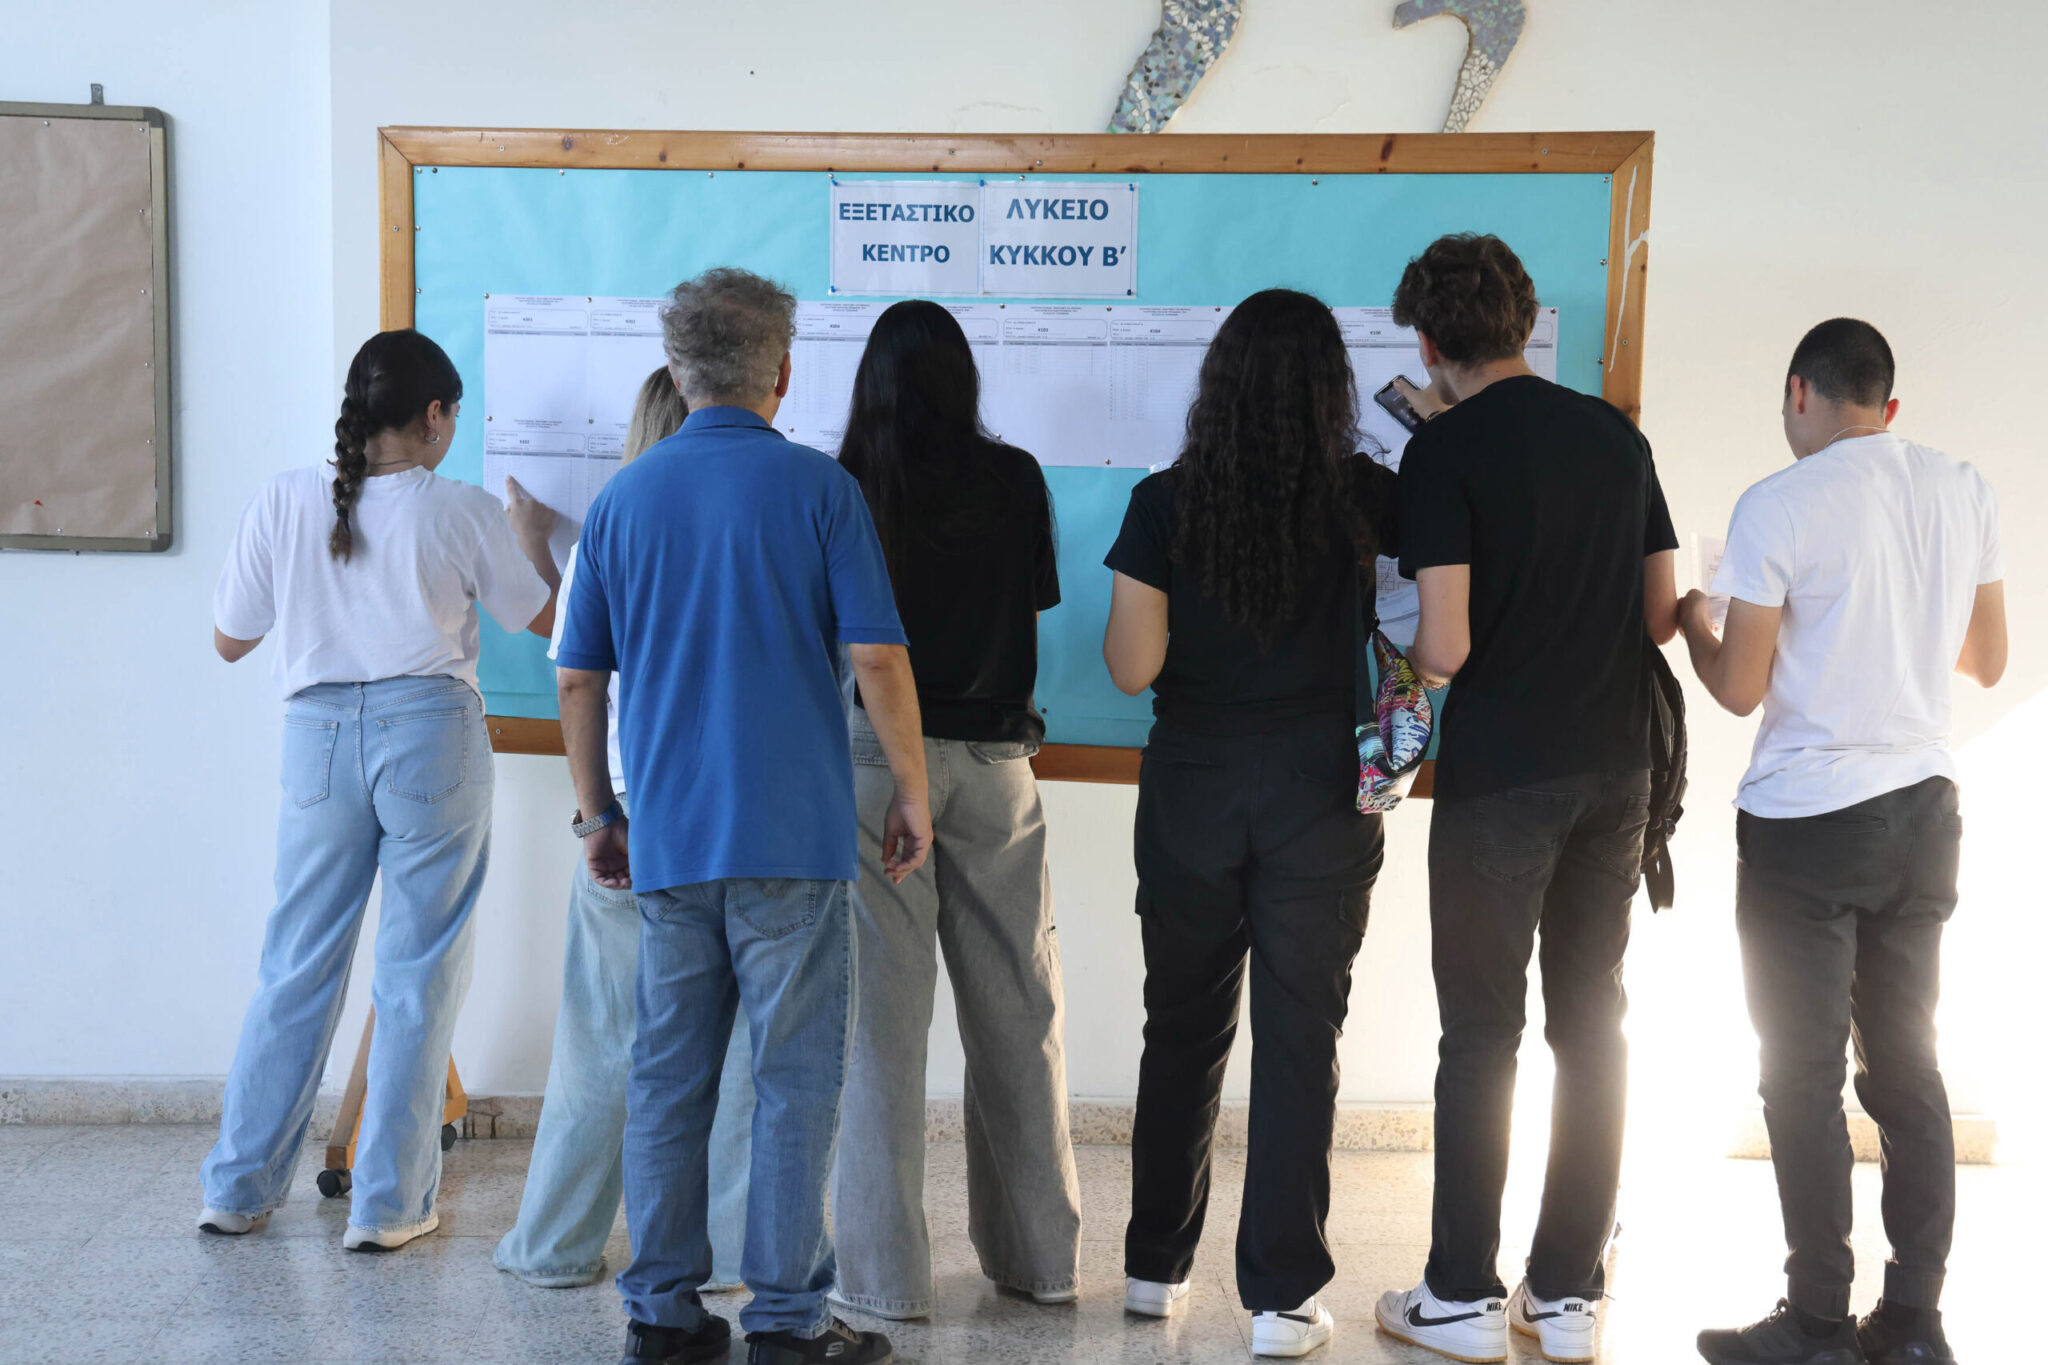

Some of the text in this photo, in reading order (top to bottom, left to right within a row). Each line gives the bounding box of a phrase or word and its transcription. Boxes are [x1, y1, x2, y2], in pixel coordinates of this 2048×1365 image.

[839, 203, 975, 223] ΕΞΕΤΑΣΤΙΚΟ
[1006, 198, 1109, 221] ΛΥΚΕΙΟ
[862, 244, 950, 263] ΚΕΝΤΡΟ
[990, 245, 1095, 266] ΚΥΚΚΟΥ
[1486, 1301, 1502, 1312] NIKE
[1563, 1302, 1583, 1312] NIKE
